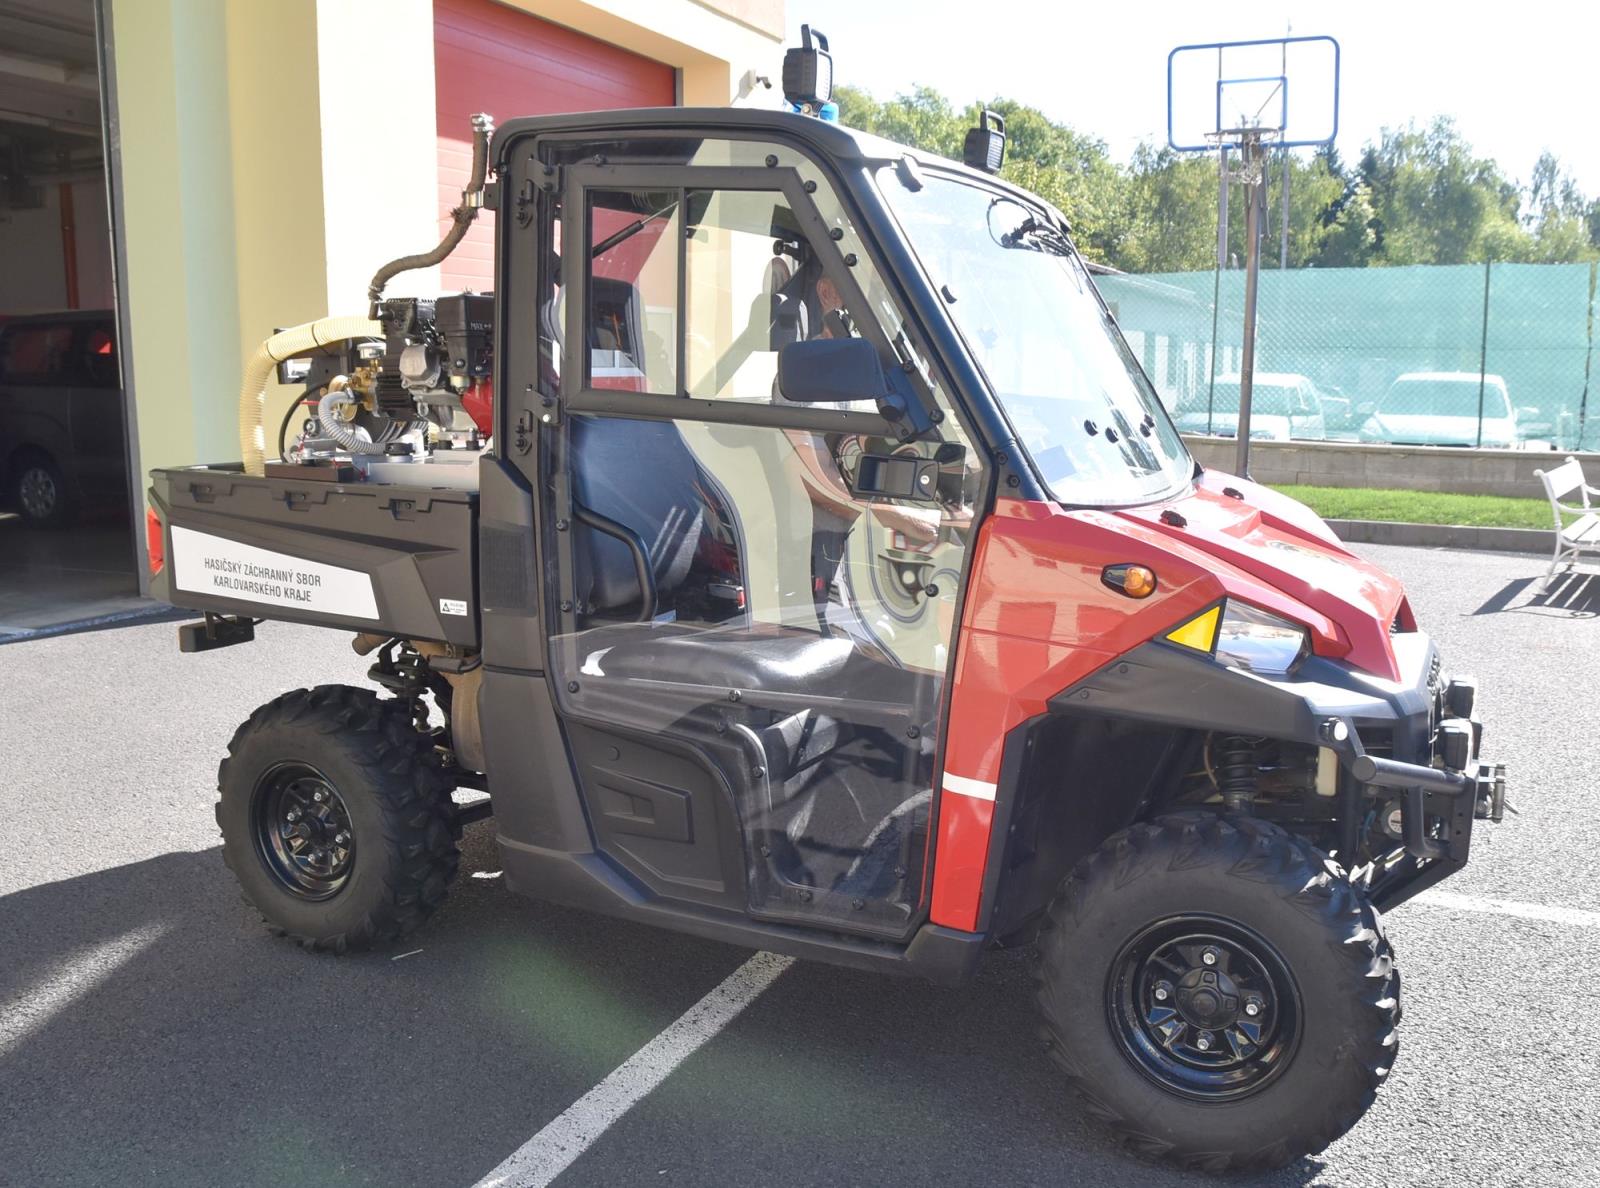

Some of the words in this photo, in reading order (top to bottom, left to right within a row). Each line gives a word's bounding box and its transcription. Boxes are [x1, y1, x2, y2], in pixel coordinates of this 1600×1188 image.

[204, 557, 242, 574] HASIČSKÝ
[243, 563, 294, 583] ZÁCHRANNÝ
[296, 572, 321, 587] SBOR
[213, 575, 282, 598] KARLOVARSKÉHO
[284, 587, 312, 602] KRAJE
